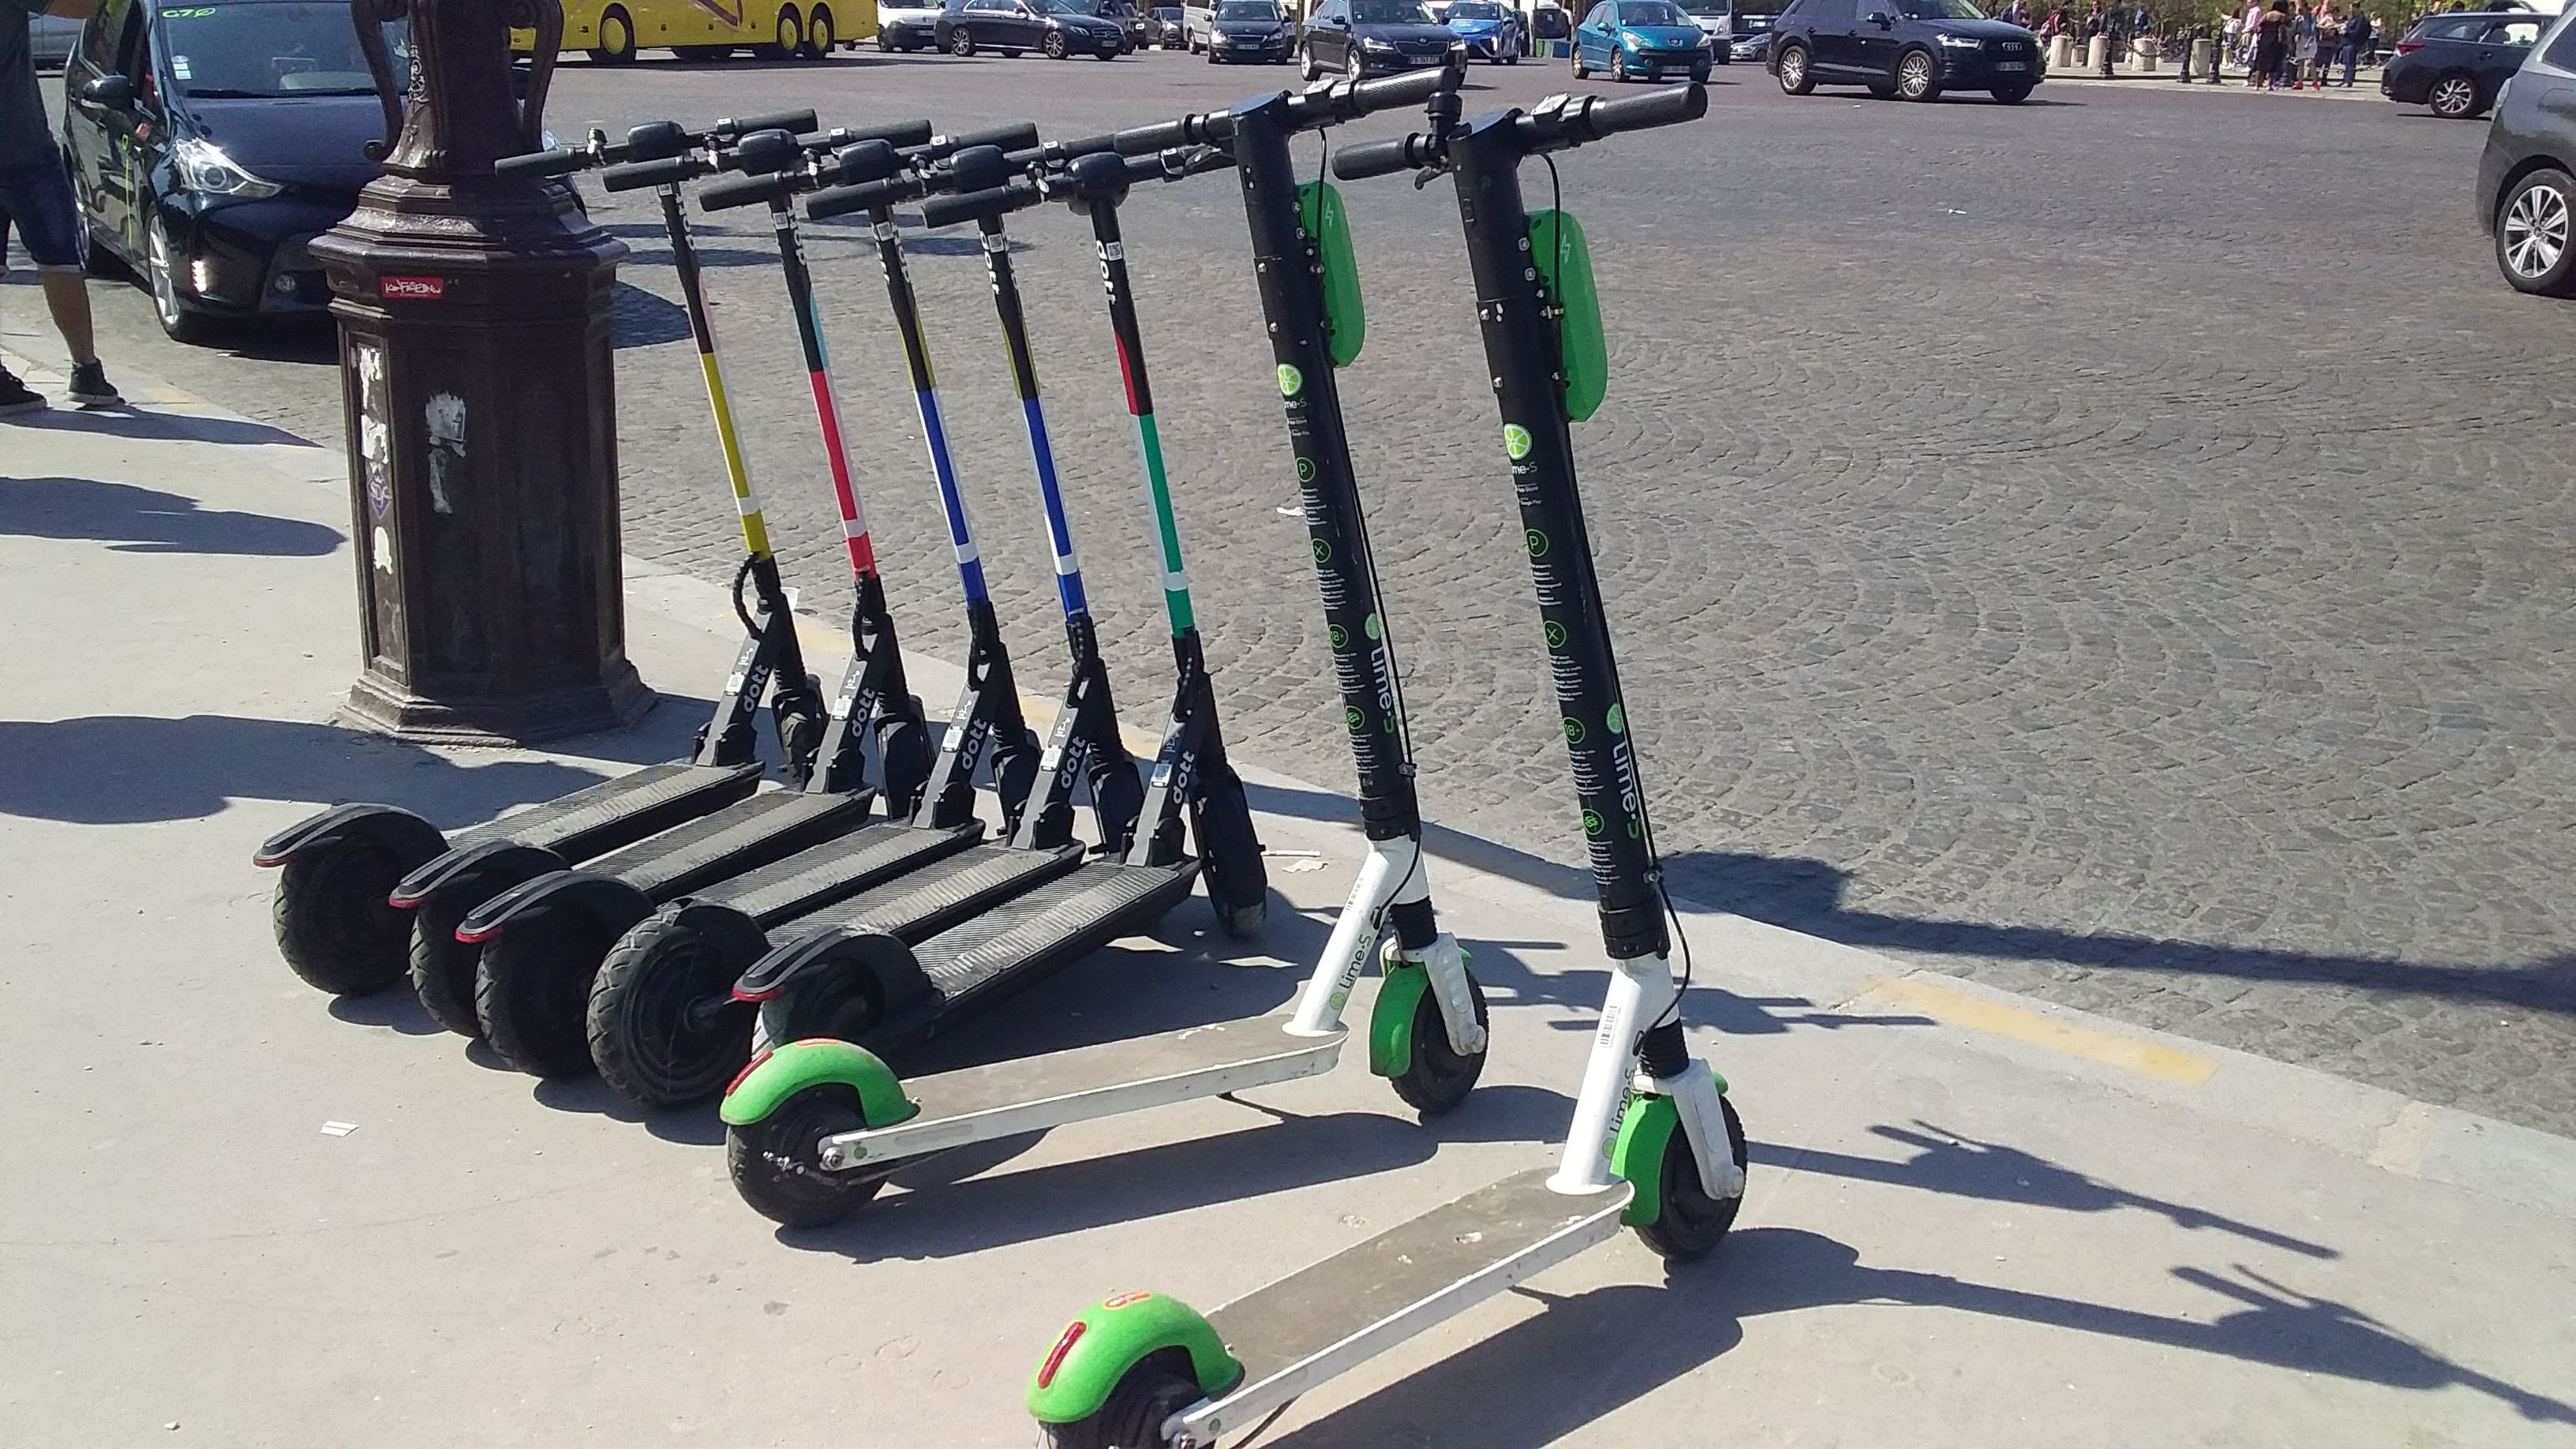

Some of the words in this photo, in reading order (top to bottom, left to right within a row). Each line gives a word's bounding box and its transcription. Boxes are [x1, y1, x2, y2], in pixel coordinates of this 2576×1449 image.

[743, 665, 769, 713] dott
[852, 687, 875, 737] dott
[961, 717, 987, 770] dott
[1061, 736, 1086, 789] dott
[1173, 751, 1195, 805] dott
